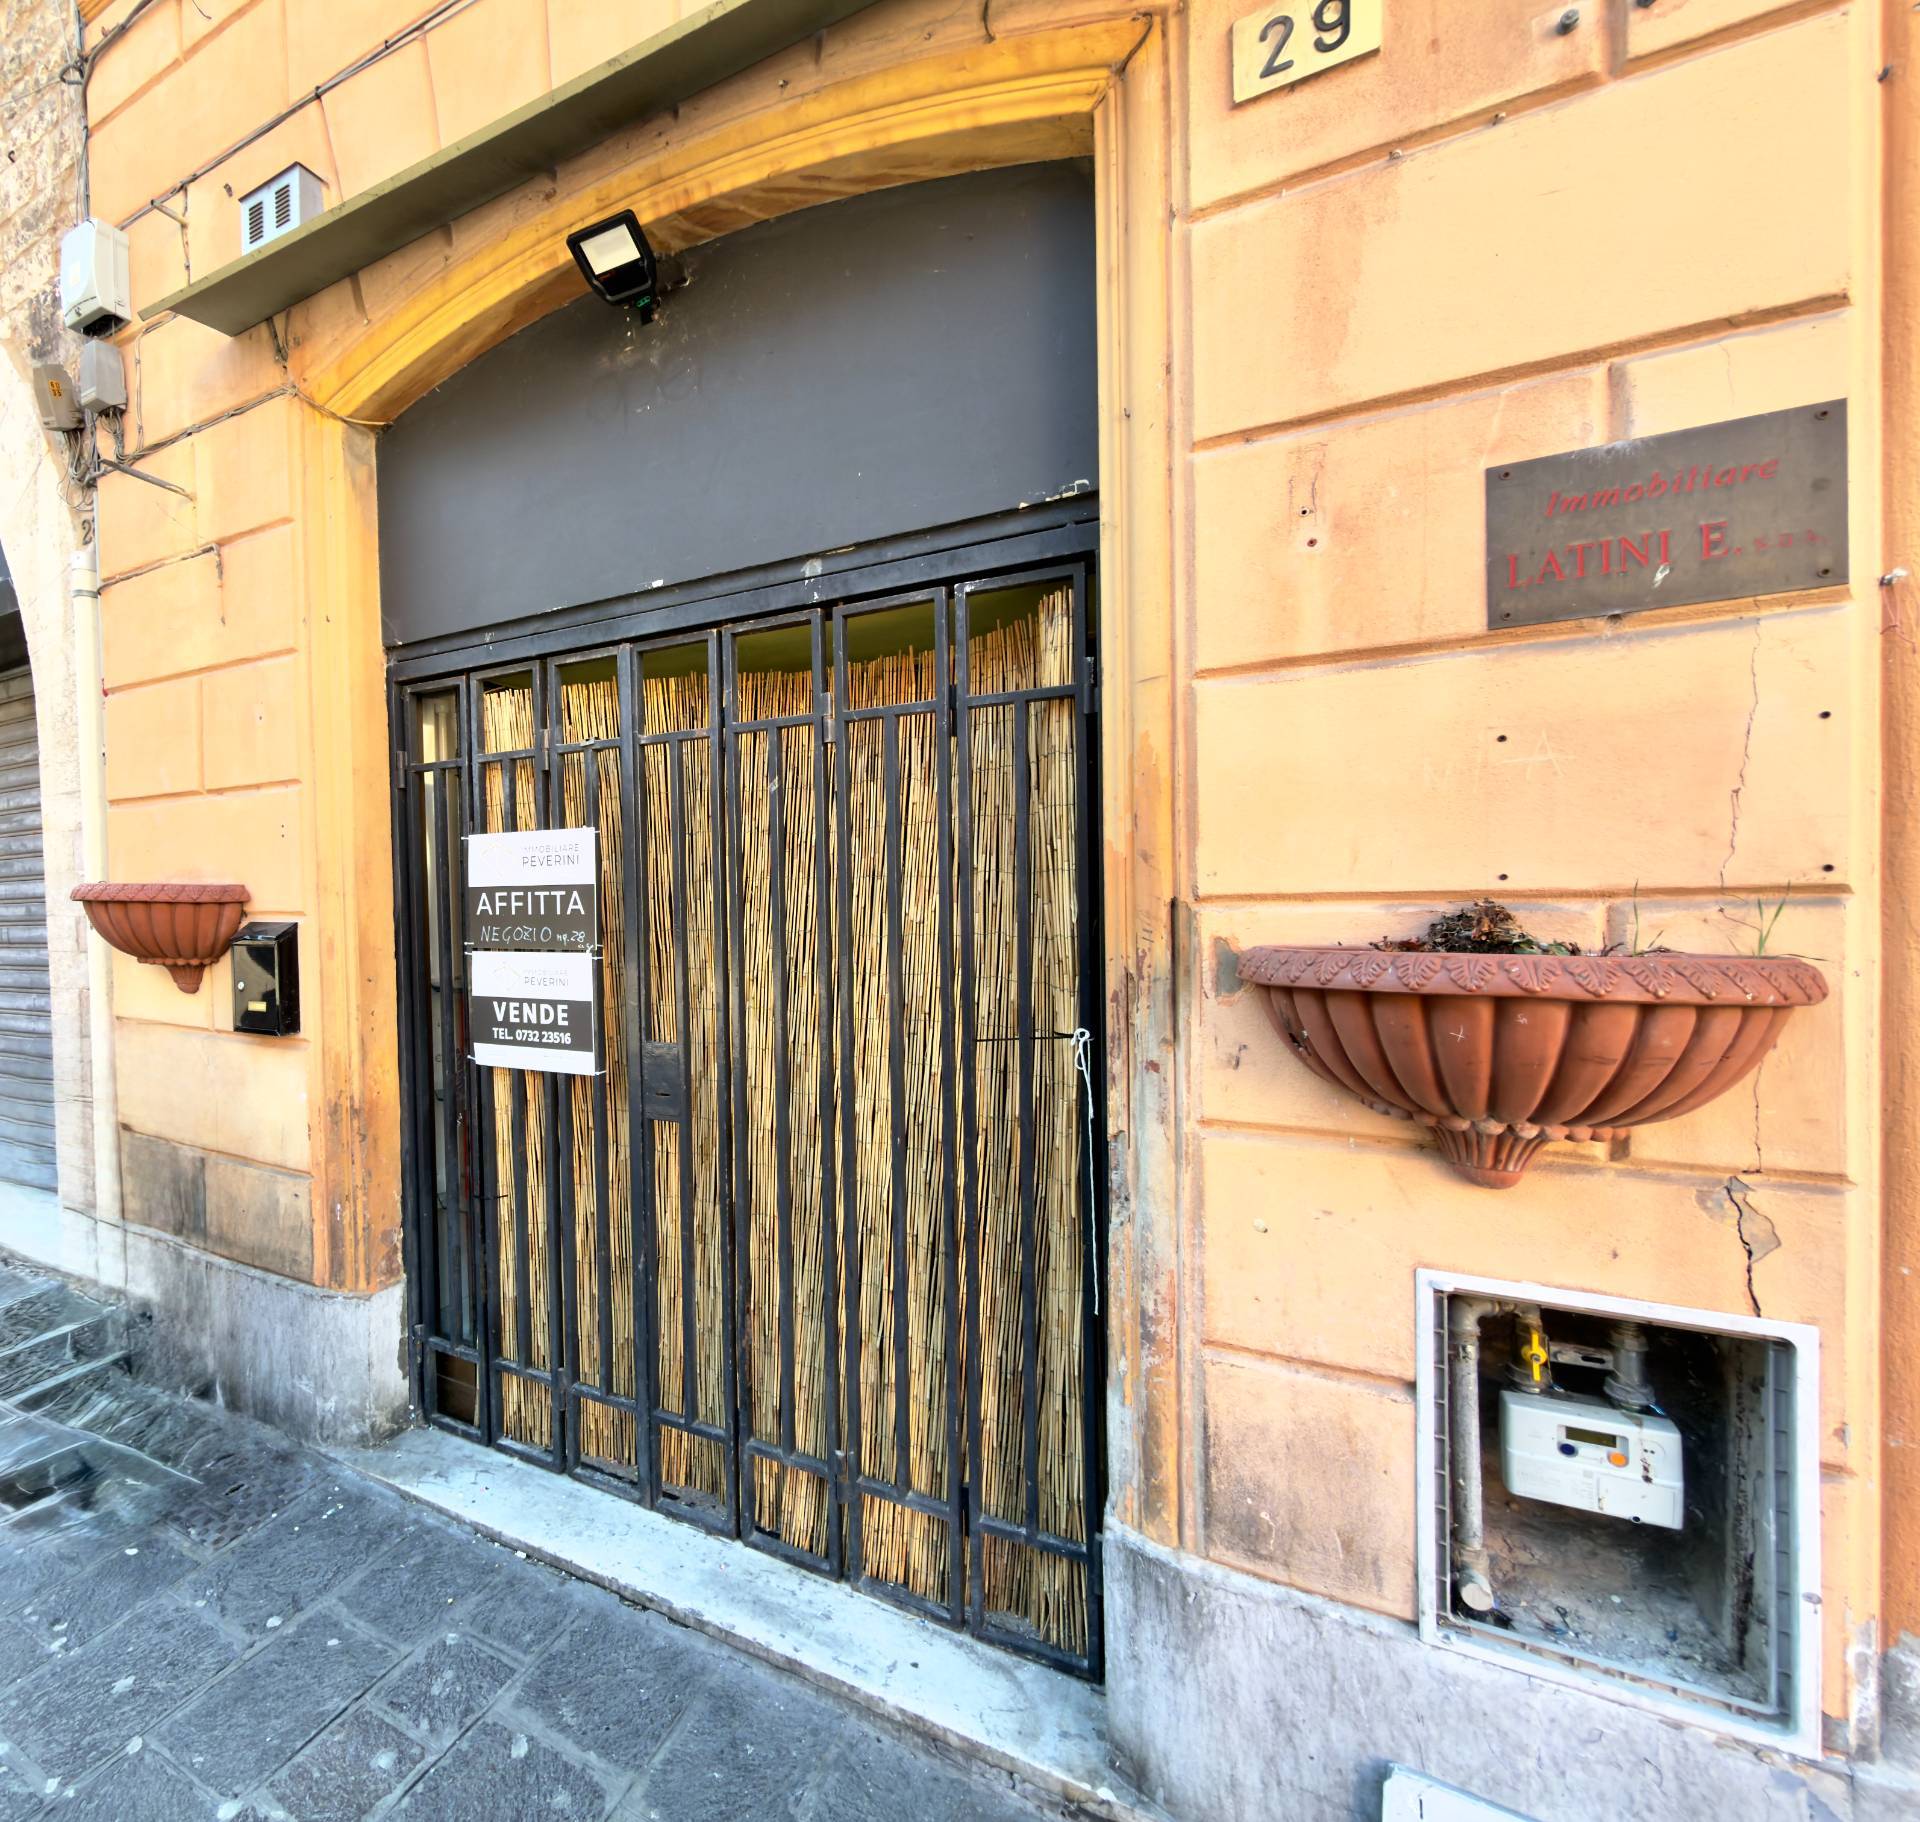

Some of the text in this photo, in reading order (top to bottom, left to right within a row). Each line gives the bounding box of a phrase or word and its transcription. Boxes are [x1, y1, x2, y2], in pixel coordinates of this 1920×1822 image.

[1259, 0, 1350, 79] 29
[1543, 458, 1780, 519] Immobiliare
[1505, 528, 1673, 591] LATINI
[519, 843, 580, 854] MMOBILIARE
[522, 854, 579, 867] PEVERINI
[476, 890, 585, 916] AFFITTA
[480, 925, 552, 944] NEGOZIO
[524, 976, 569, 987] PEVERINI
[492, 1000, 569, 1026] VENDE
[492, 1027, 572, 1045] TEL. 0732 23516
